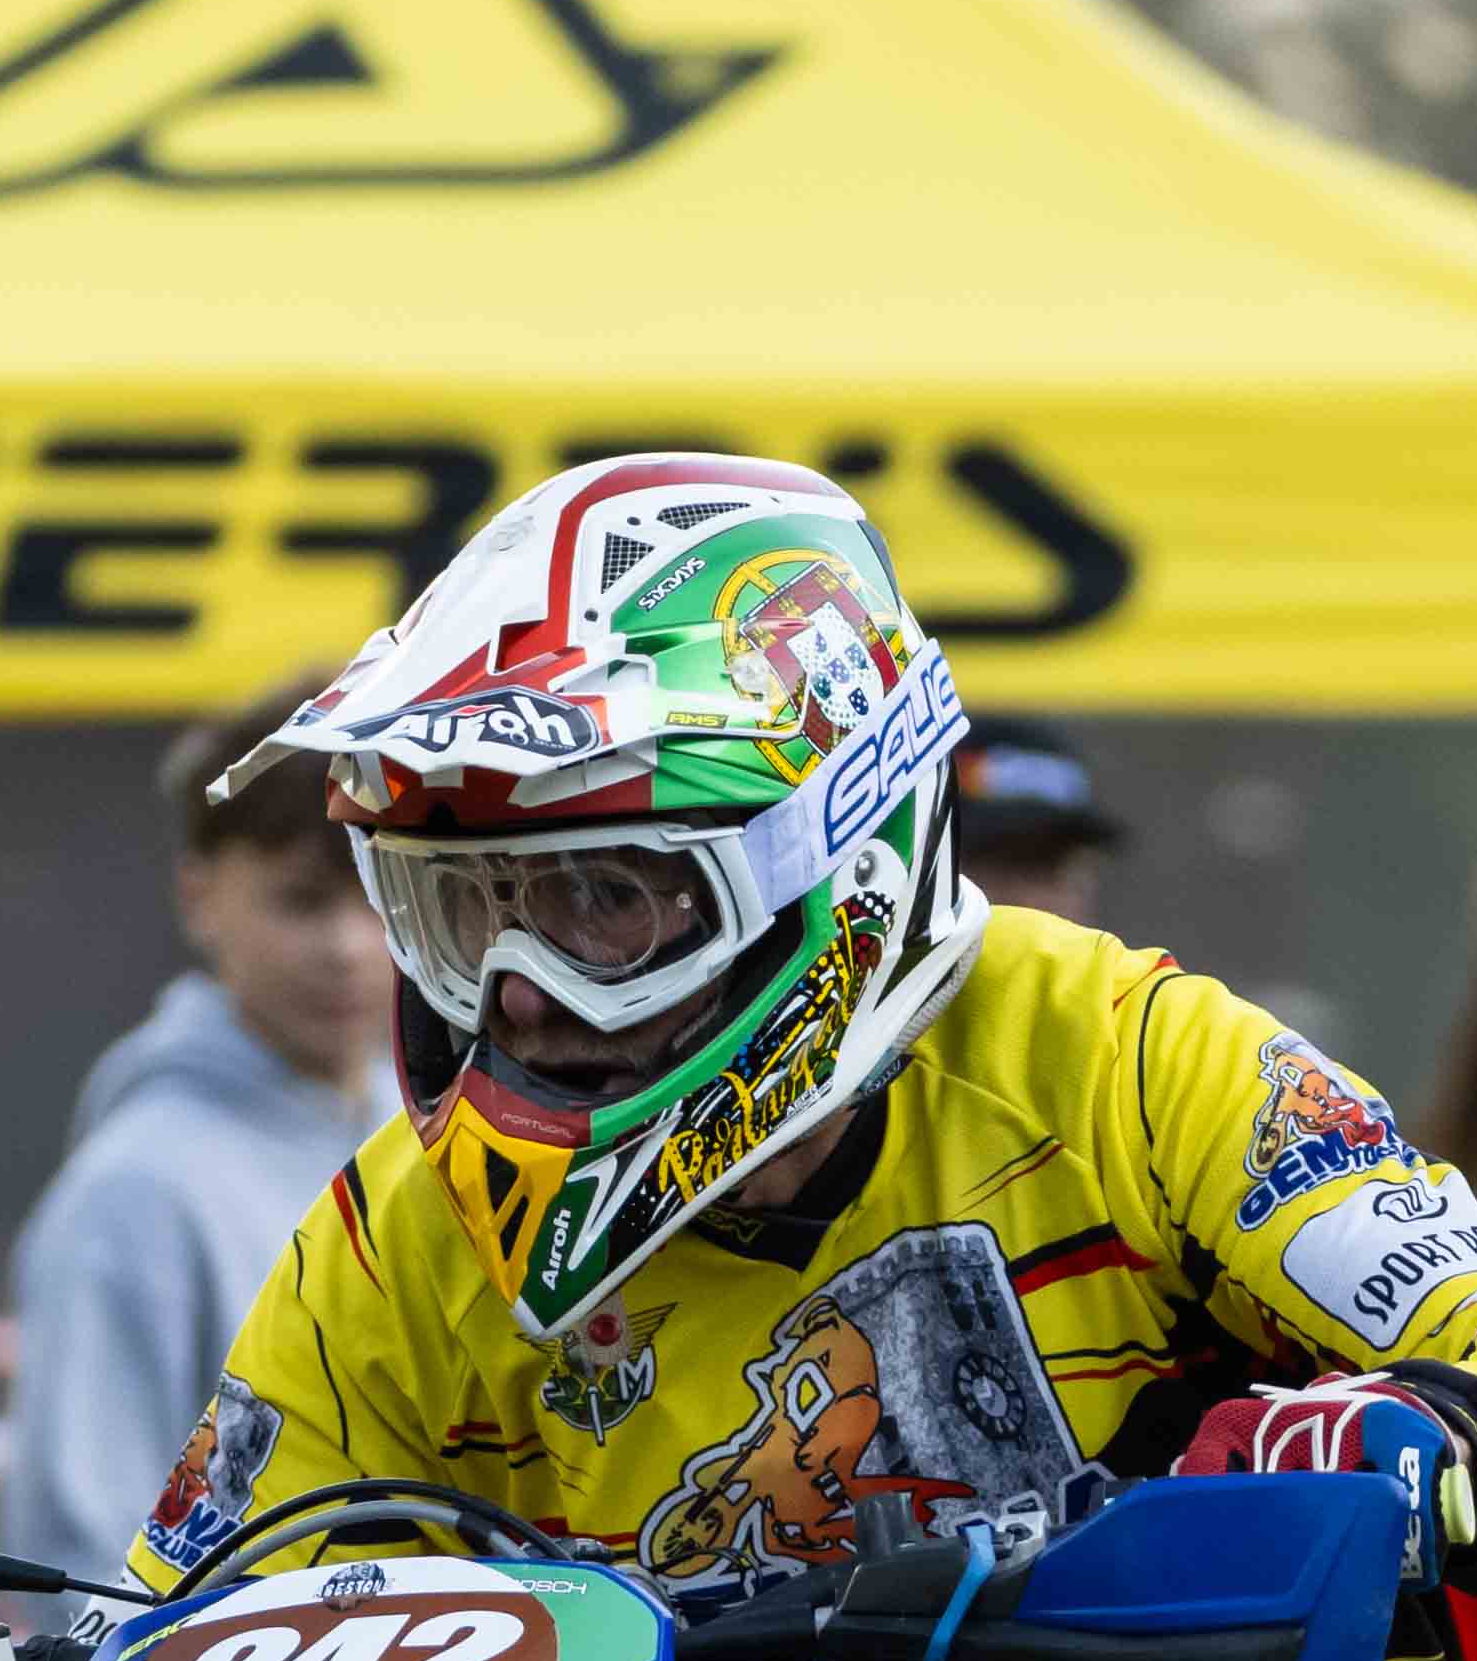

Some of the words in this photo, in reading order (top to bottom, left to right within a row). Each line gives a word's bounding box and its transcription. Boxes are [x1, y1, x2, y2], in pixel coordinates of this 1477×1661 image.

[638, 555, 707, 611] SIXDAYS
[541, 1208, 572, 1290] Airoh
[1354, 1230, 1463, 1326] SPORT
